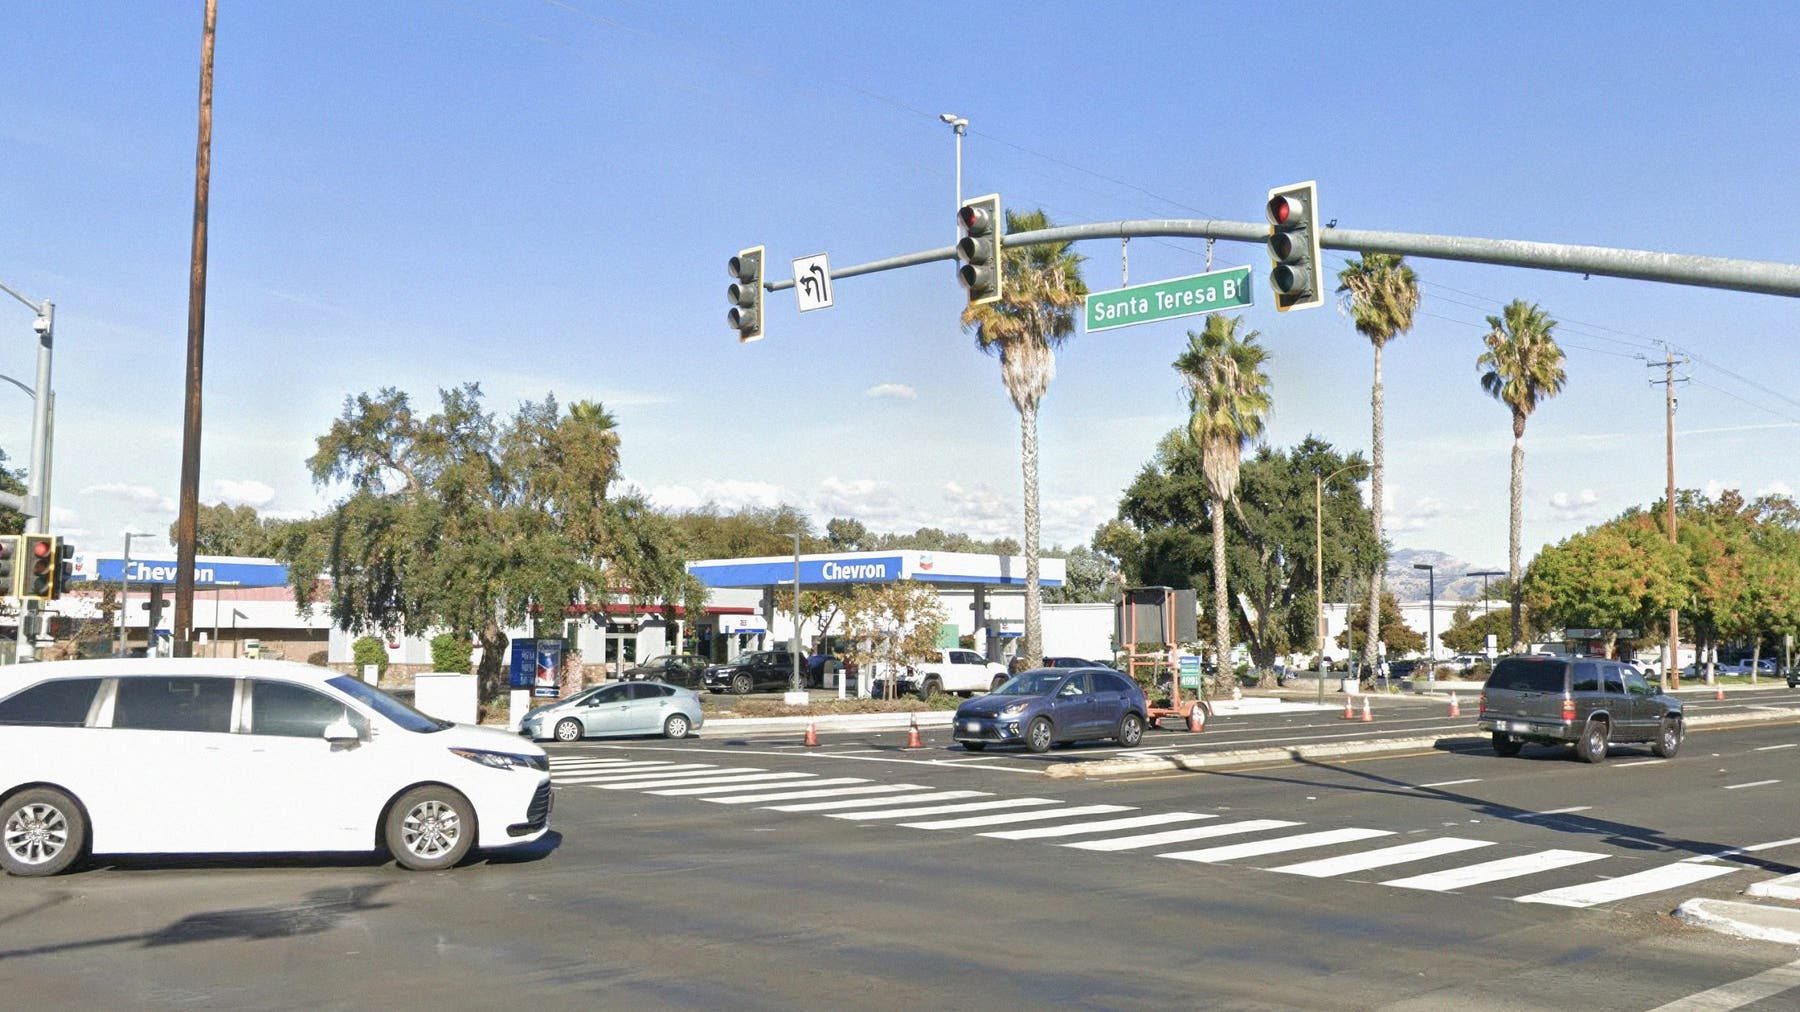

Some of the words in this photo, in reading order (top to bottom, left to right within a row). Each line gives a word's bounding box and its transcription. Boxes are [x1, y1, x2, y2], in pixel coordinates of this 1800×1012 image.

[1094, 297, 1148, 321] Santa
[1155, 286, 1216, 310] Teresa
[822, 561, 886, 580] Chevron
